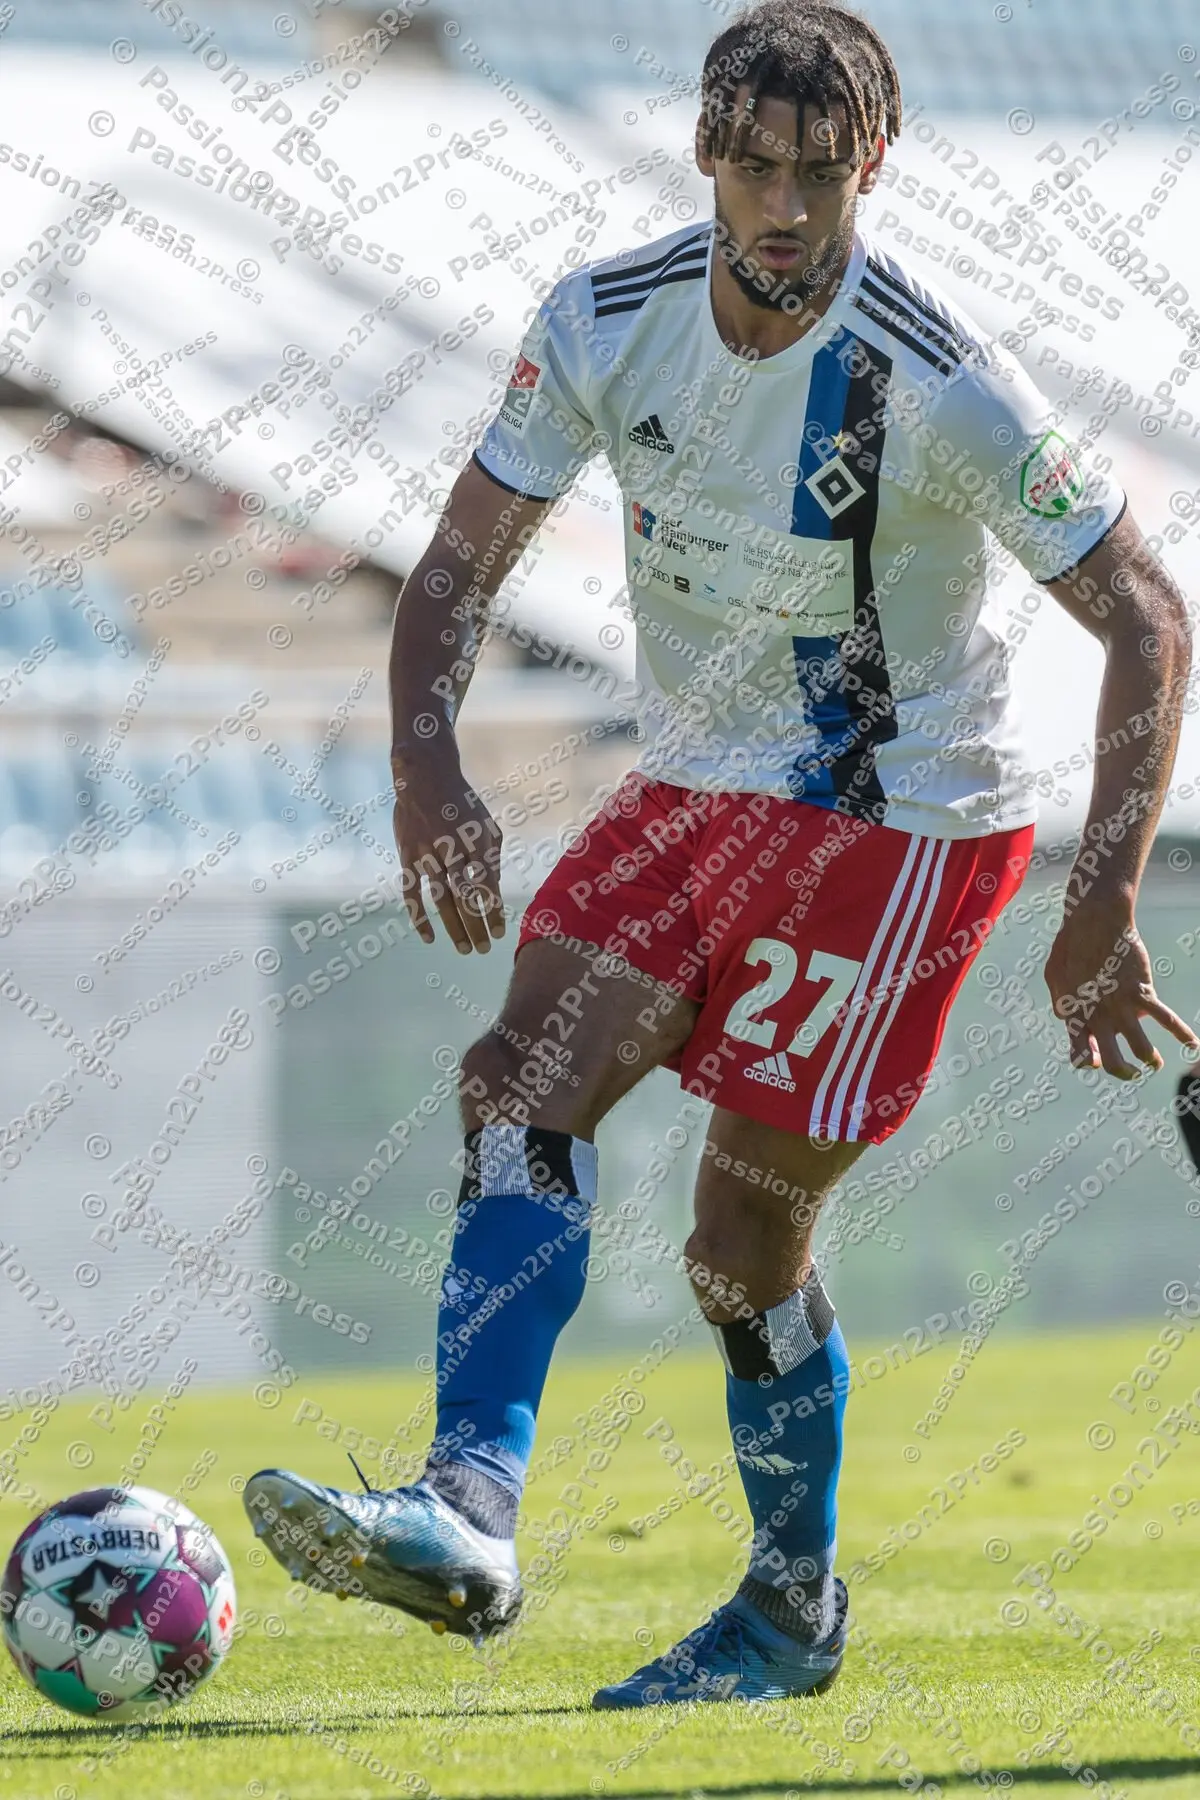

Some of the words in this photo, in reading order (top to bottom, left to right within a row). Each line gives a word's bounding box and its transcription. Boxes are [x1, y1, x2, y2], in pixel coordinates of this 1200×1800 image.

[629, 432, 675, 454] adidas
[661, 513, 683, 528] Der
[661, 525, 729, 552] Hamburger
[661, 536, 687, 555] Weg
[723, 937, 864, 1059] 27
[743, 1067, 797, 1094] adidas
[31, 1529, 161, 1573] DERBYSTAR
